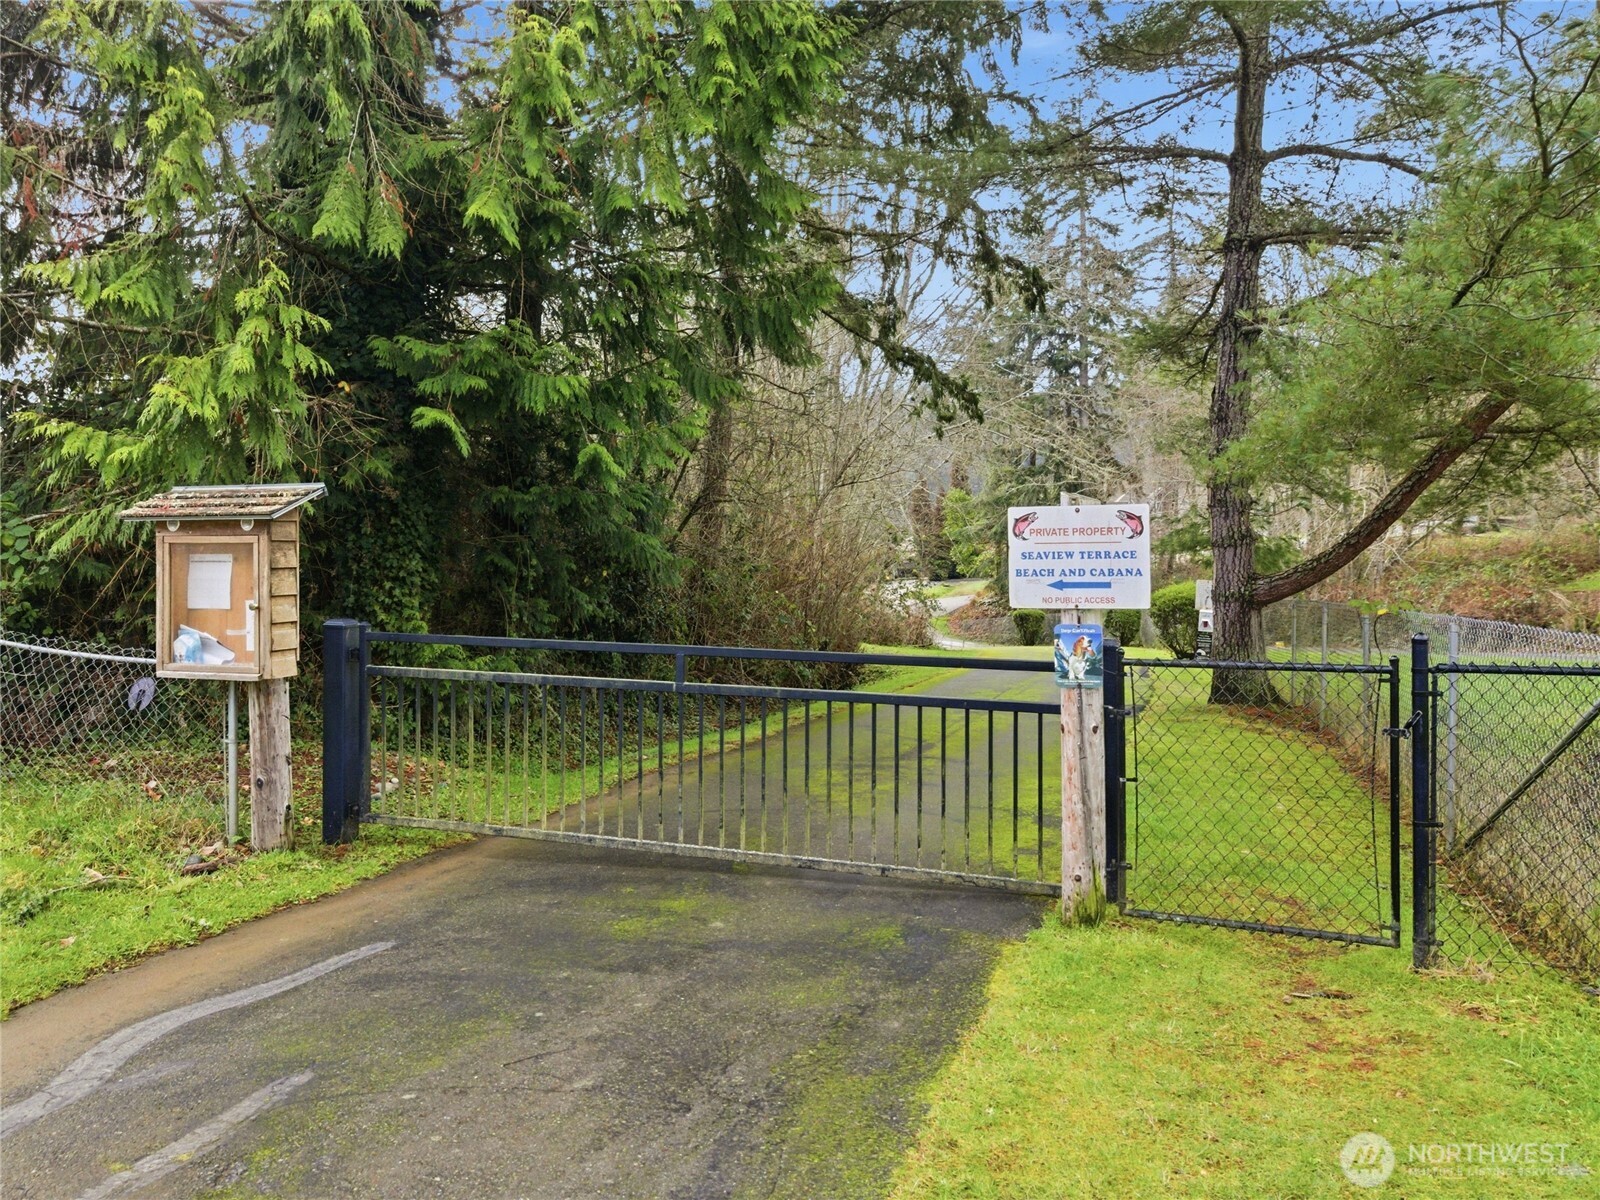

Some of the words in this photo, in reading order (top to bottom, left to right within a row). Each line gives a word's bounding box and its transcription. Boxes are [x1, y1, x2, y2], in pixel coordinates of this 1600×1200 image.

[1029, 527, 1070, 537] PRIVATE
[1072, 526, 1126, 536] PROPERTY
[1020, 550, 1075, 560] SEAVIEW
[1079, 550, 1138, 559] TERRACE
[1015, 568, 1055, 577] BEACH
[1058, 568, 1086, 577] AND
[1090, 567, 1143, 577] CABANA
[1055, 596, 1082, 604] PUBLIC
[1084, 596, 1116, 604] ACCESS
